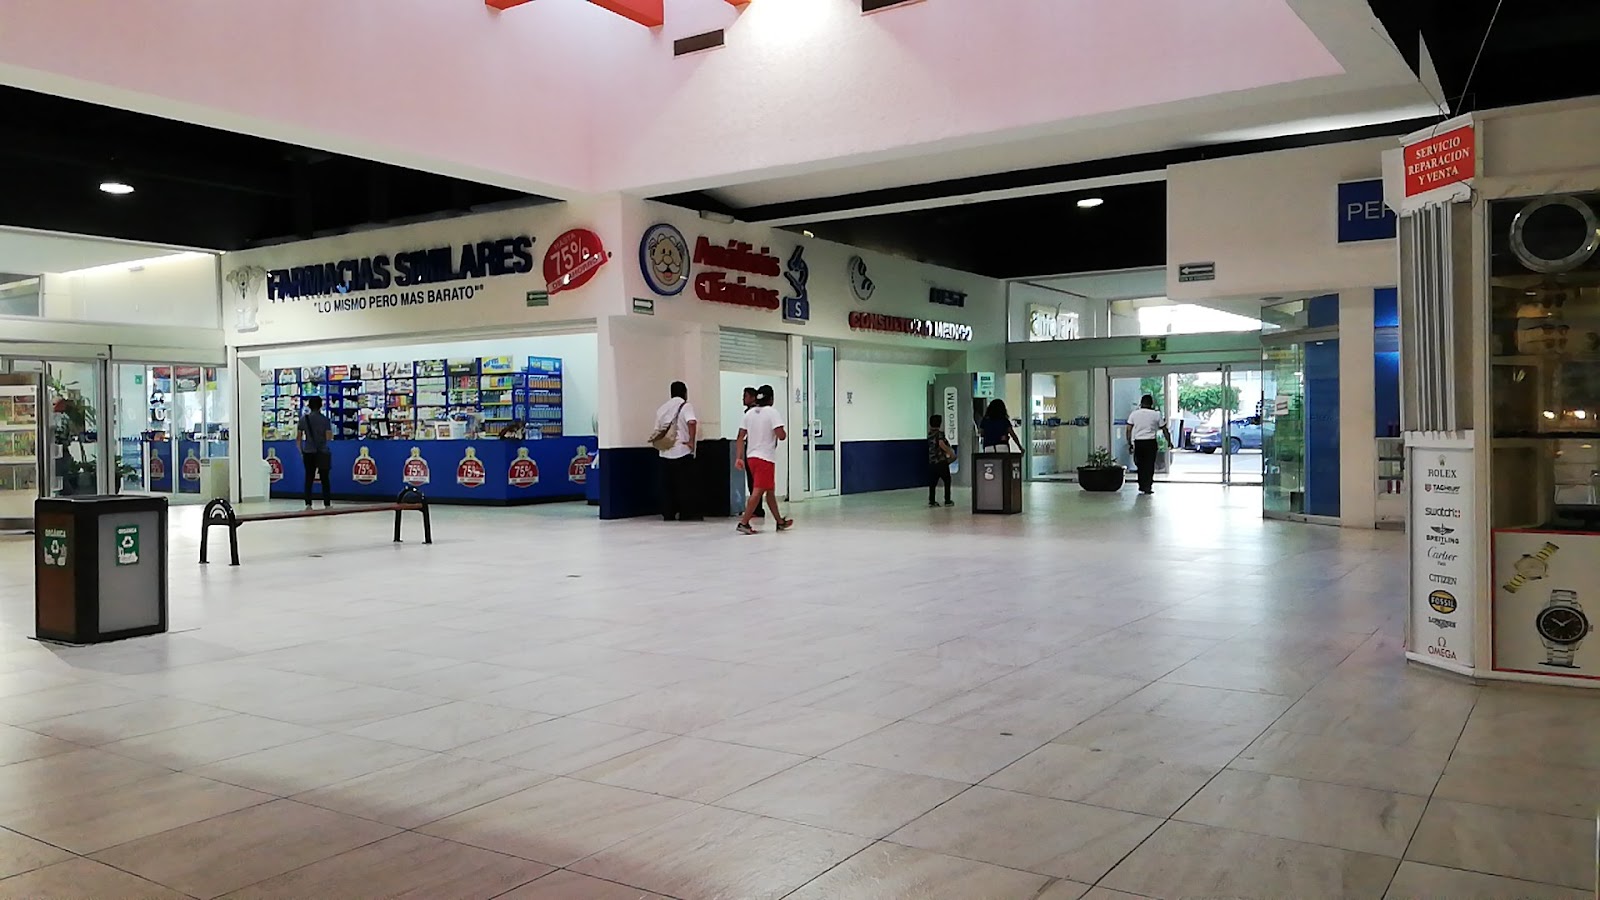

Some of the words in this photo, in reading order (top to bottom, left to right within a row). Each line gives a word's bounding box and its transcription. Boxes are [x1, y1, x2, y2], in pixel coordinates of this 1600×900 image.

[1416, 136, 1461, 160] SERVICIO
[1408, 147, 1470, 176] REPARACION
[1418, 175, 1426, 186] Y
[1427, 165, 1459, 183] VENTA
[553, 232, 577, 250] HASTA
[550, 237, 590, 276] 75%
[267, 255, 391, 303] FARMACIAS
[394, 235, 533, 286] SIMILARES
[334, 297, 367, 312] MISMO
[369, 293, 398, 309] PERO
[400, 290, 424, 306] MAS
[795, 302, 802, 317] S
[848, 311, 932, 338] CONSULTORIO
[934, 321, 973, 341] MEDICO
[947, 392, 955, 411] ATM
[948, 413, 956, 440] Cajero
[357, 463, 373, 475] 75%
[408, 465, 425, 477] 75%
[514, 465, 534, 478] 75%
[1428, 468, 1457, 479] ROLEX
[1425, 507, 1455, 518] swatch
[1426, 534, 1459, 544] BREITLING
[1427, 546, 1458, 561] Cartier
[1428, 573, 1457, 586] CITIZEN
[1431, 595, 1455, 608] FOSSIL
[1428, 645, 1457, 660] OMEGA
